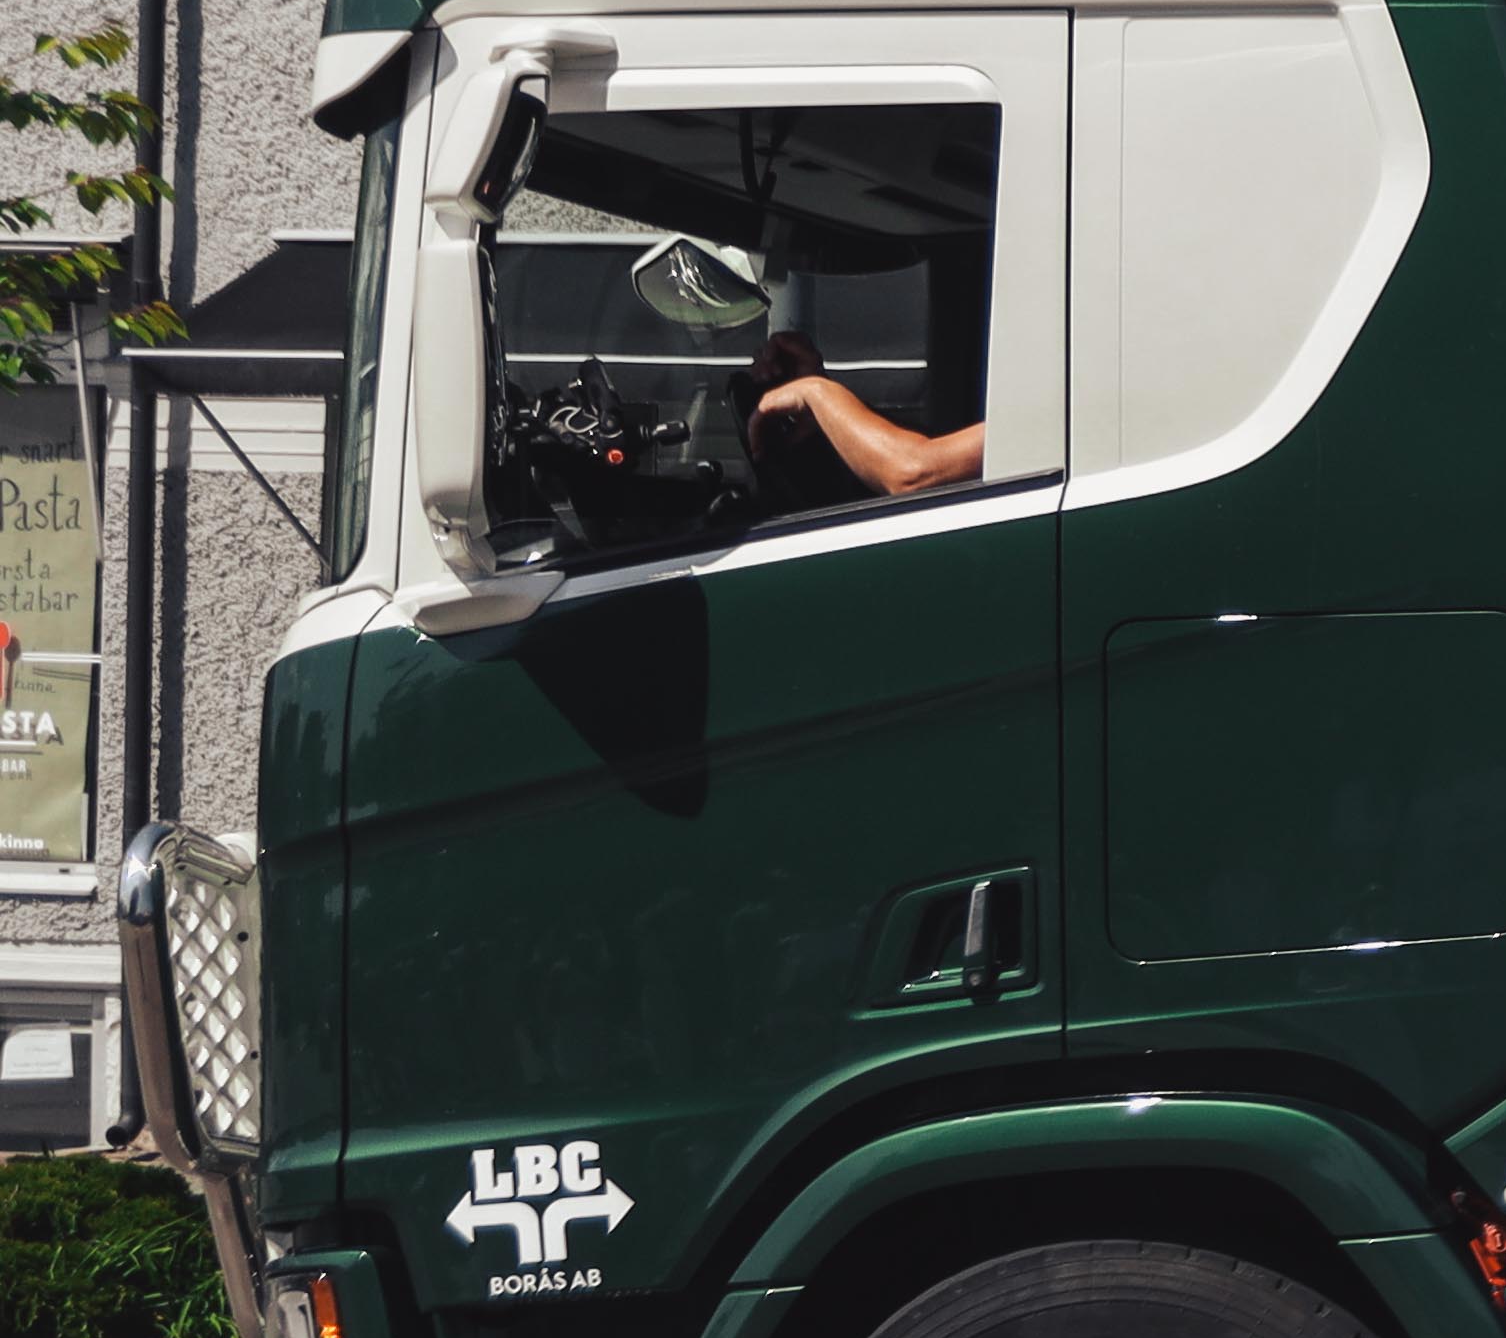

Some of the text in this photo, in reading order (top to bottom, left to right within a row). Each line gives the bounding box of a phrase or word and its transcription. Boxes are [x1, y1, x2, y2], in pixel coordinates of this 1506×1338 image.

[471, 1139, 602, 1202] LBC
[489, 1267, 602, 1296] BORÅS AB
